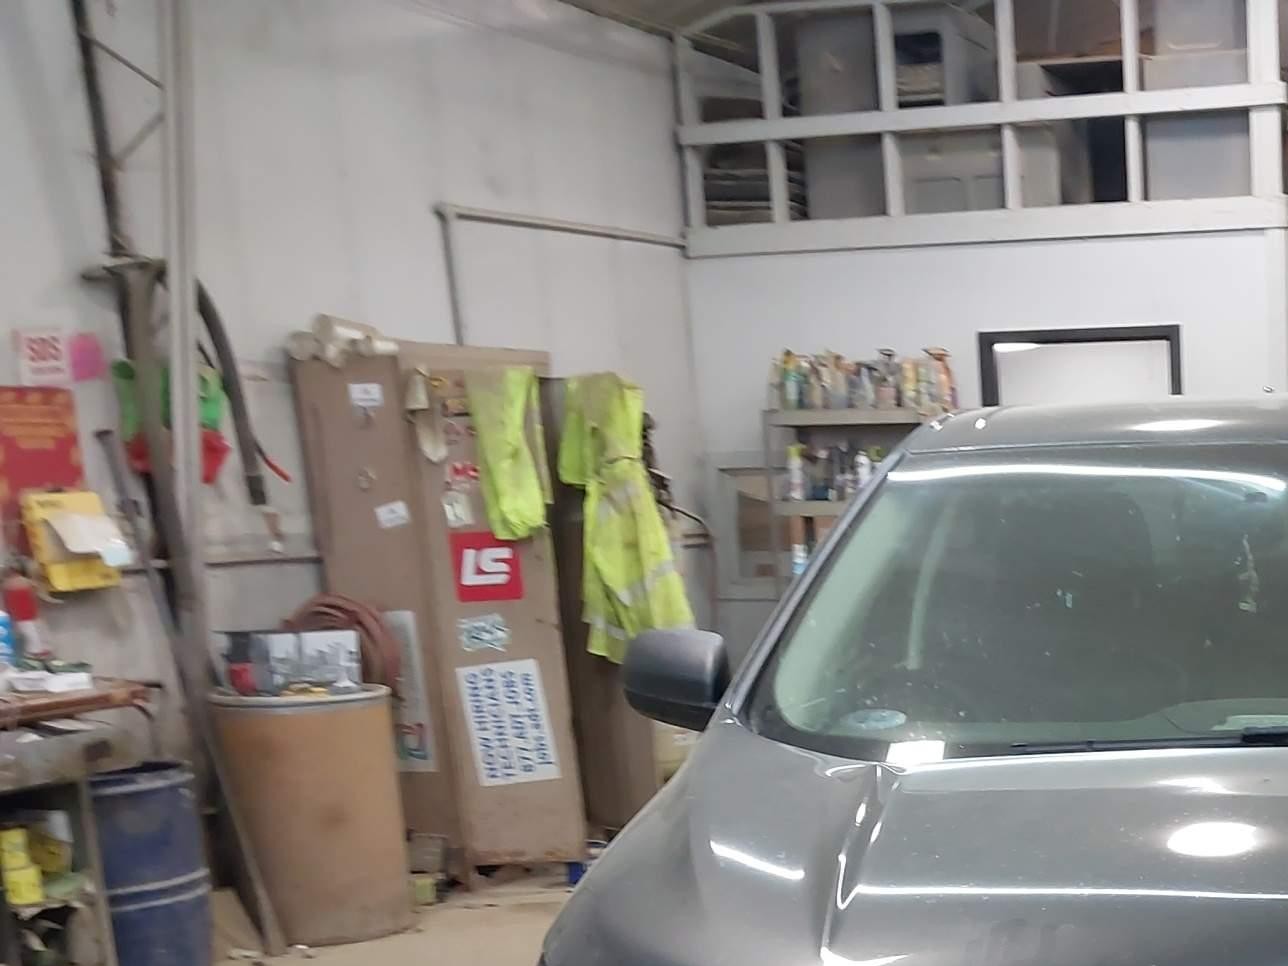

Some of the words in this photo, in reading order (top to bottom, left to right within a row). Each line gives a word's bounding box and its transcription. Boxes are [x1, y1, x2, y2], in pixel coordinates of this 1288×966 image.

[465, 671, 490, 732] HIRING
[481, 667, 518, 778] TECHNICIANS
[478, 735, 502, 779] NOW
